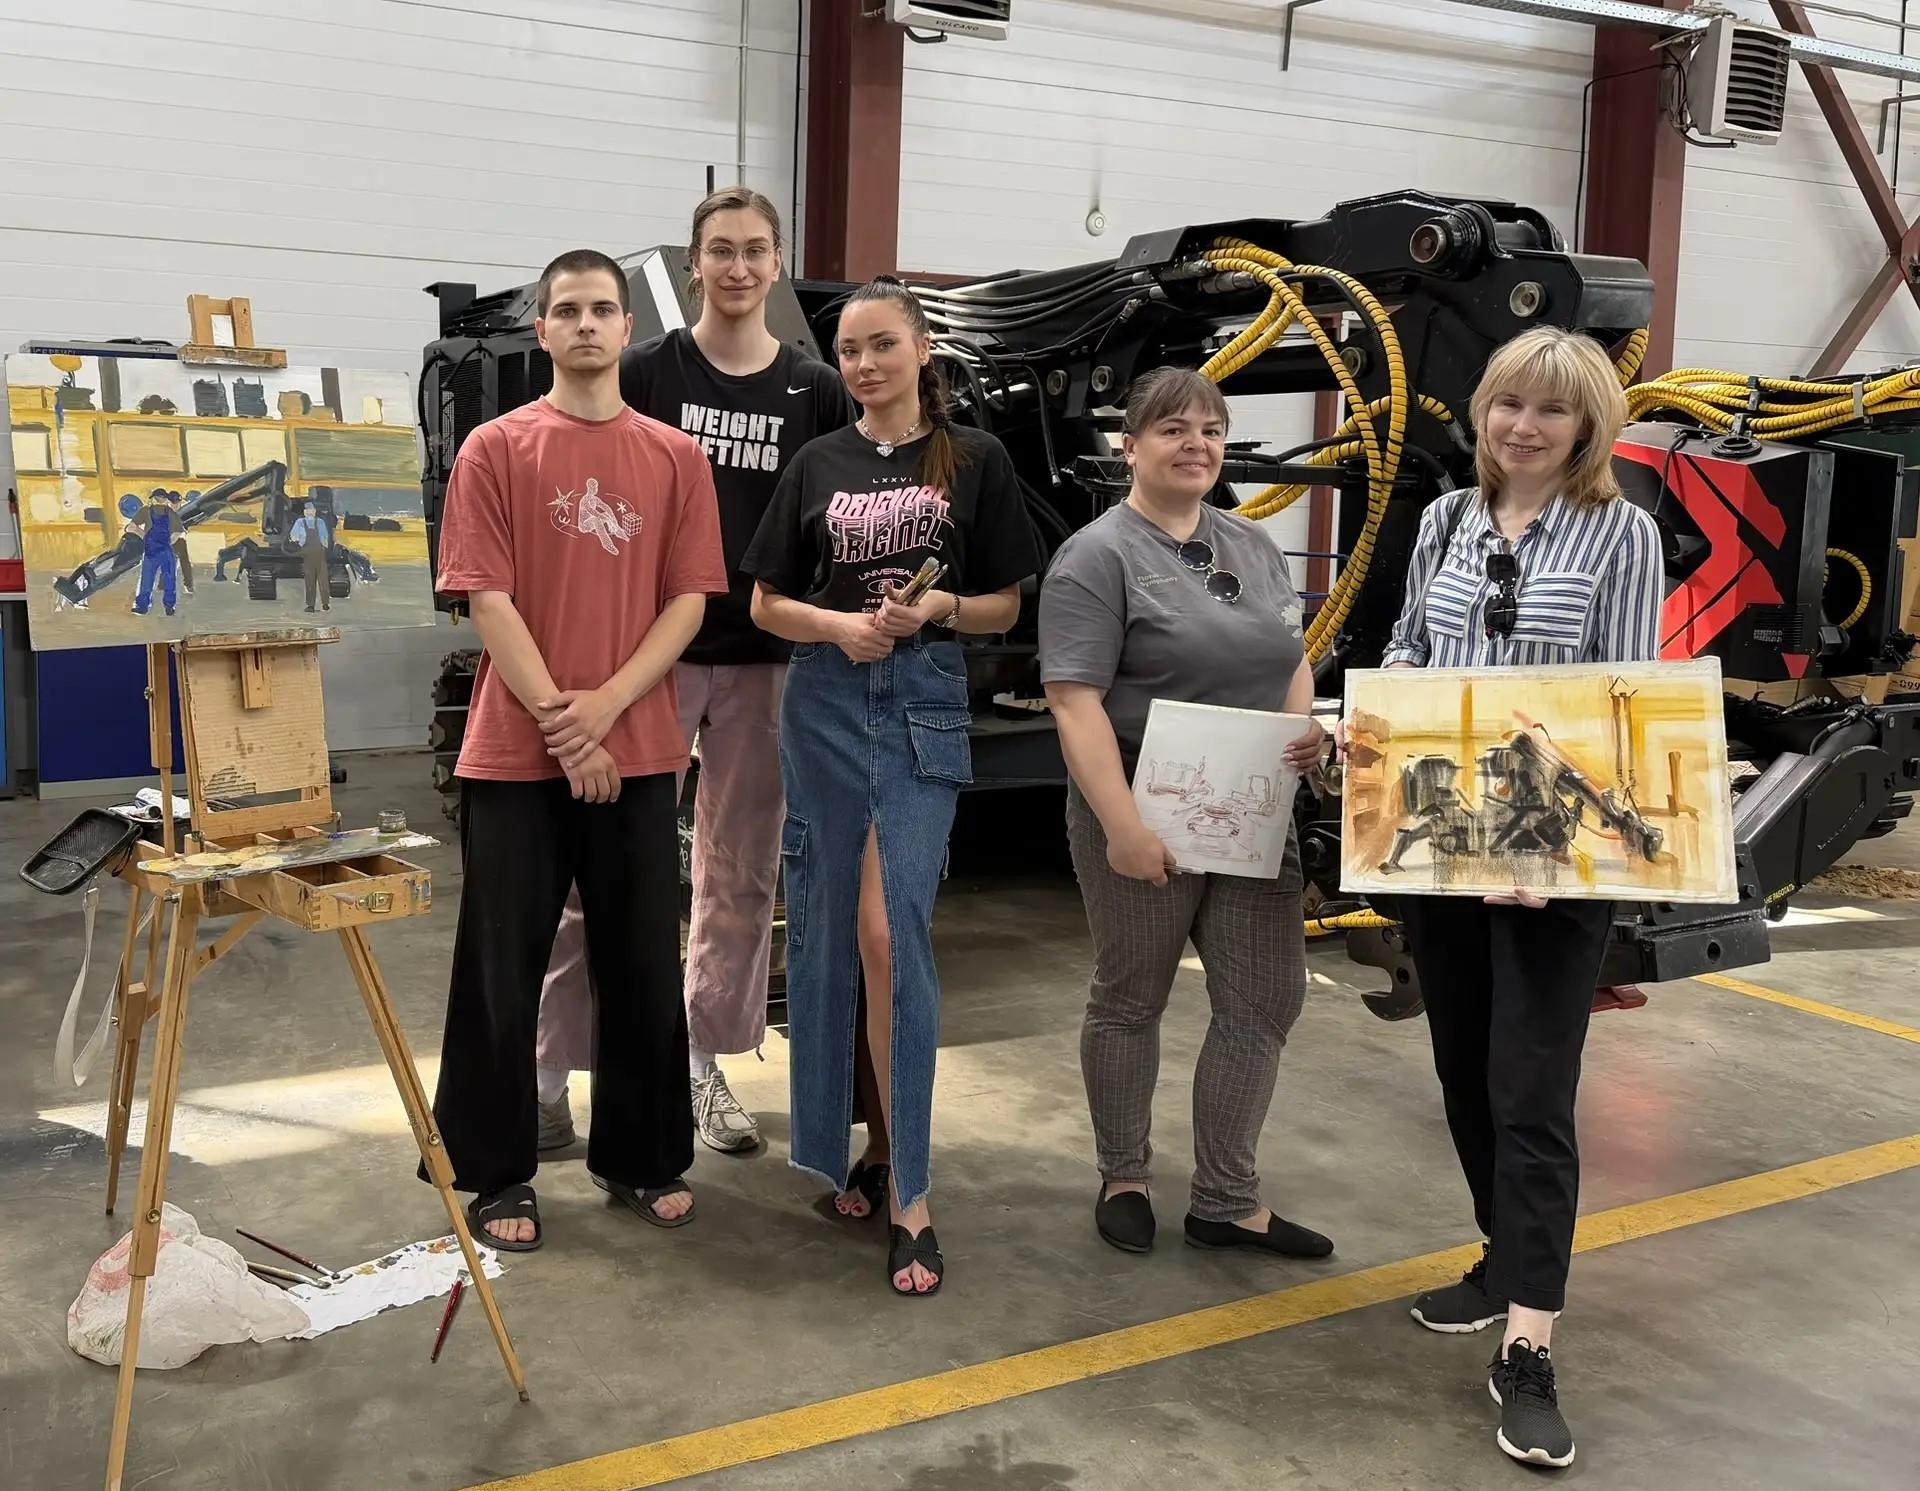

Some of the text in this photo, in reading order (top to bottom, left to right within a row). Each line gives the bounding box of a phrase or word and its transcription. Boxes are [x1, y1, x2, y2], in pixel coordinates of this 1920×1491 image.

[936, 20, 979, 31] VOLCANO
[681, 402, 785, 443] WEIGHT
[692, 433, 780, 473] FTING
[872, 476, 913, 484] LXXVI
[858, 567, 916, 582] UNIVERSAL
